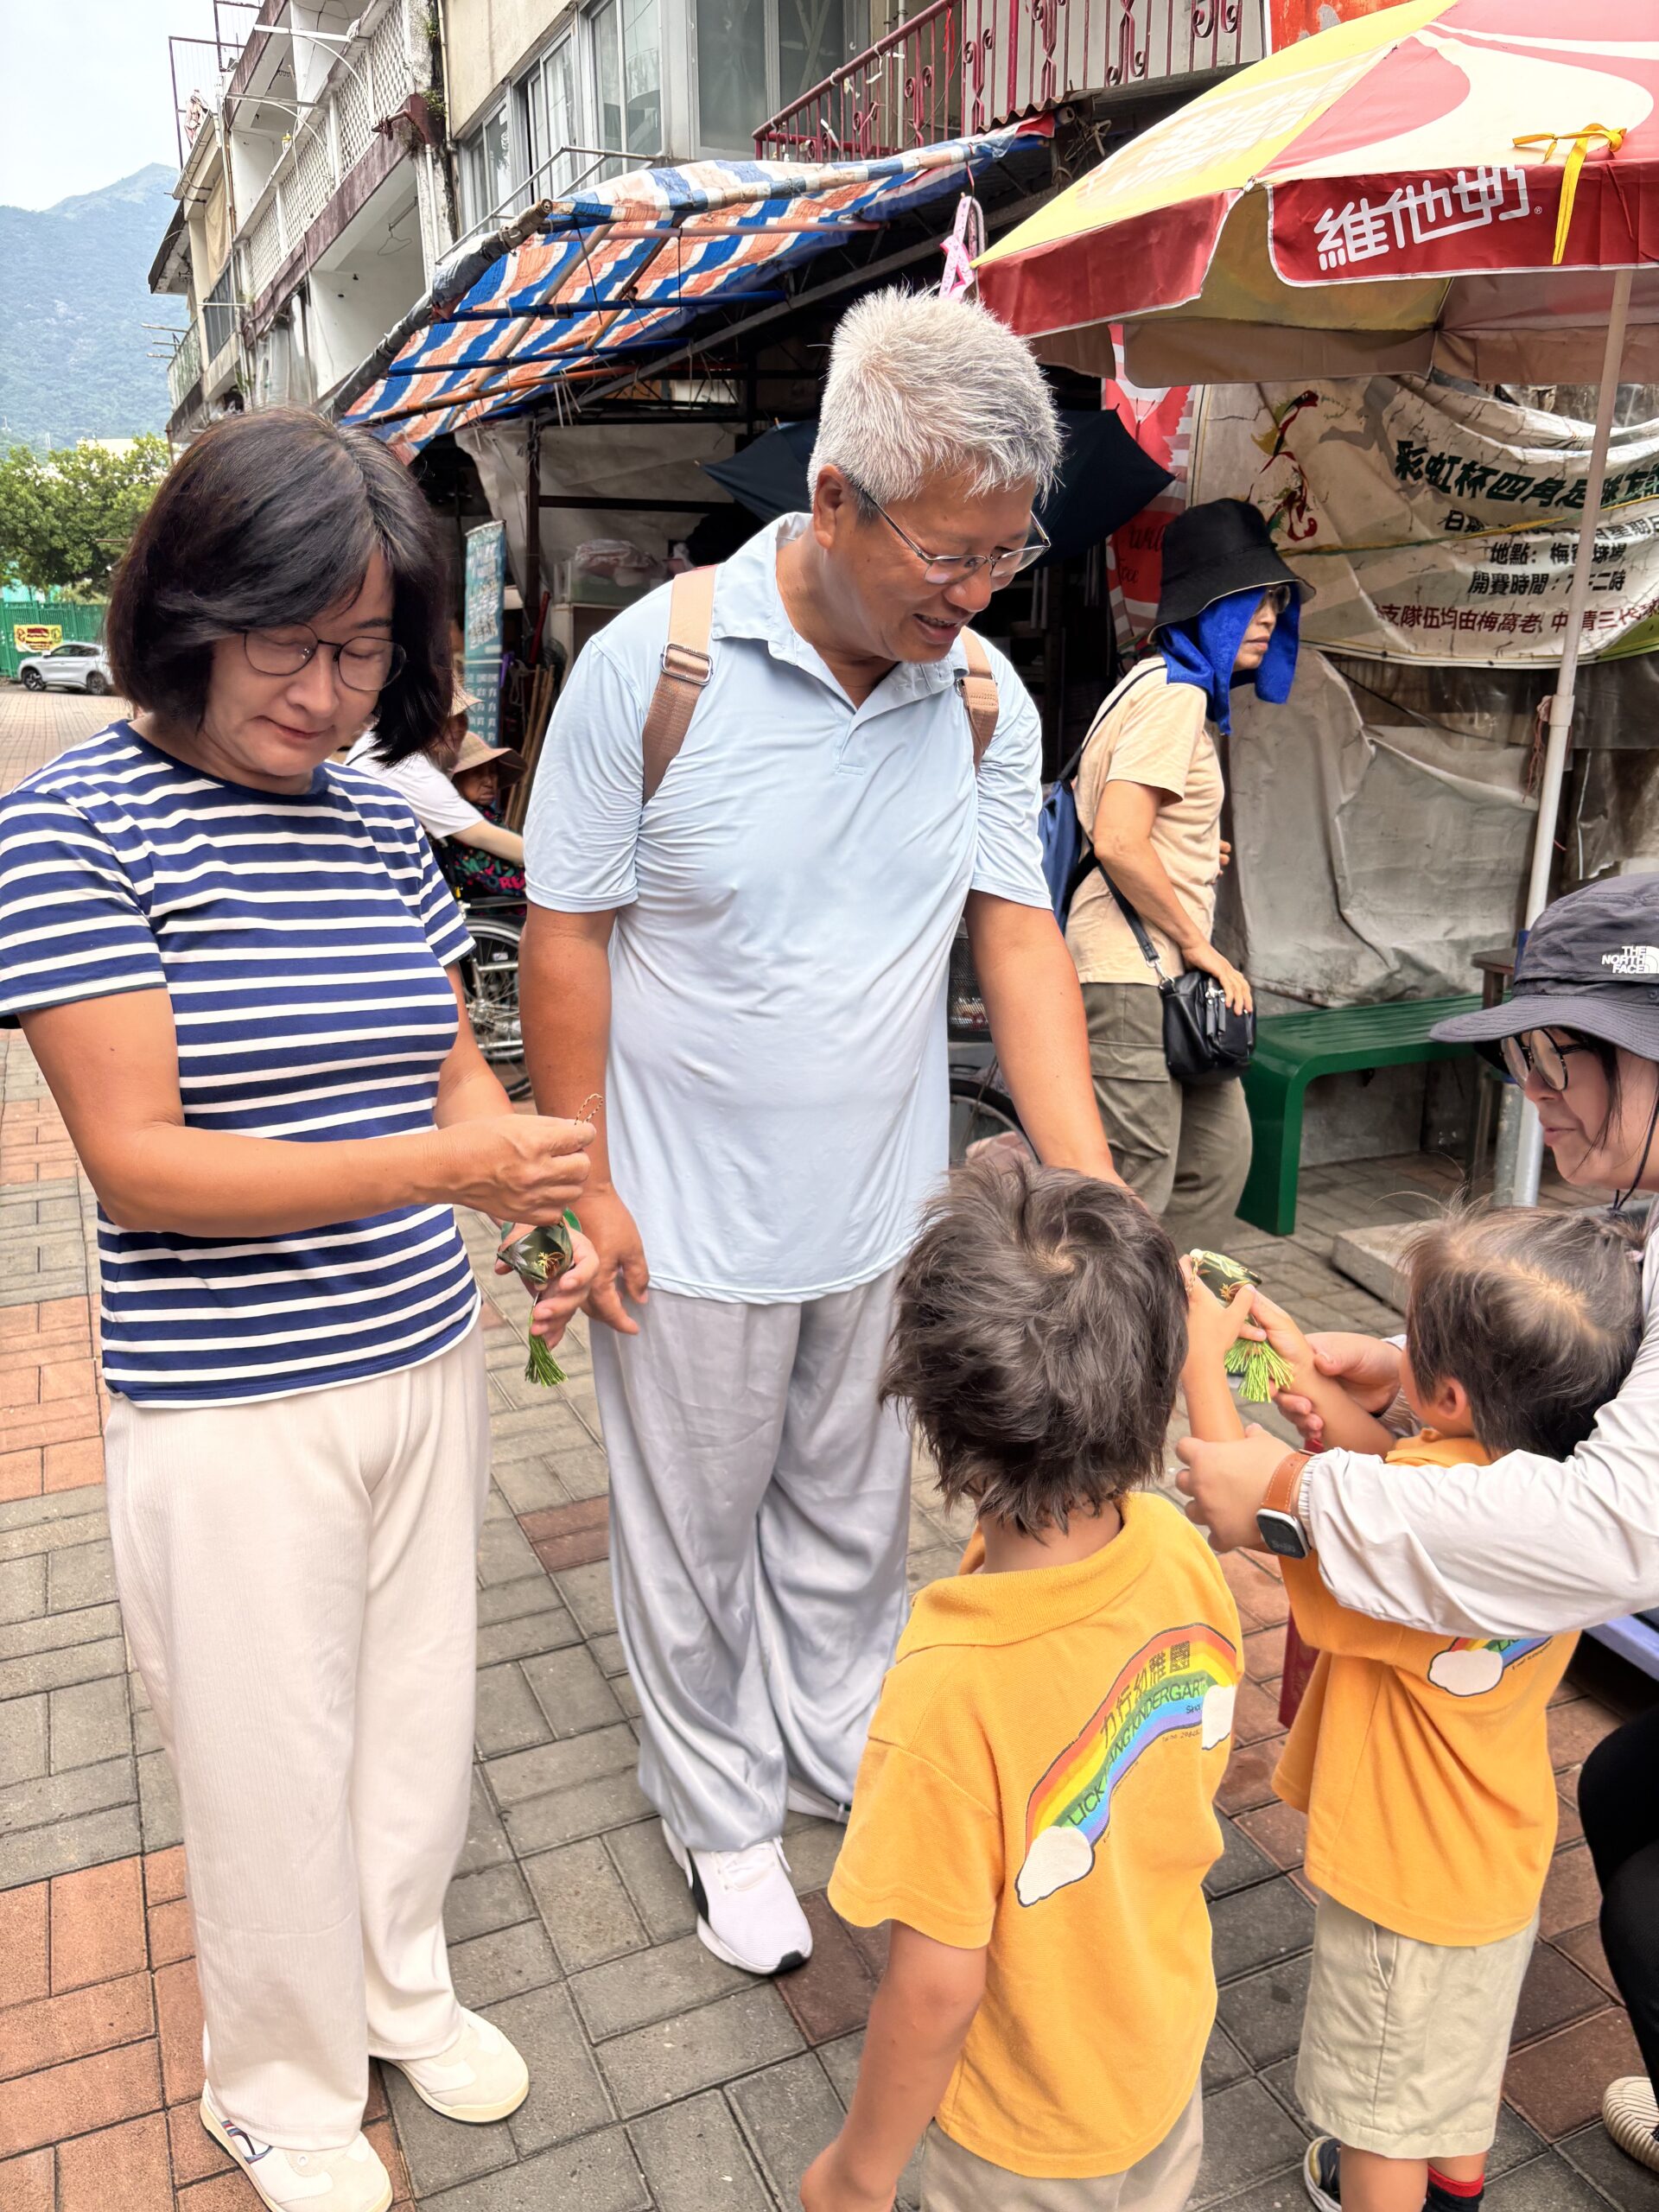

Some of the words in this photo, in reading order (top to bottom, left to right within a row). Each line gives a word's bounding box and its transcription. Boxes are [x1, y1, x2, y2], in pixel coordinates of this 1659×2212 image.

[1313, 164, 1529, 270] 維他奶
[1621, 945, 1646, 957] THE
[1601, 954, 1646, 965] NORTH
[1611, 963, 1645, 974] FACE
[1066, 1777, 1105, 1826] LICK
